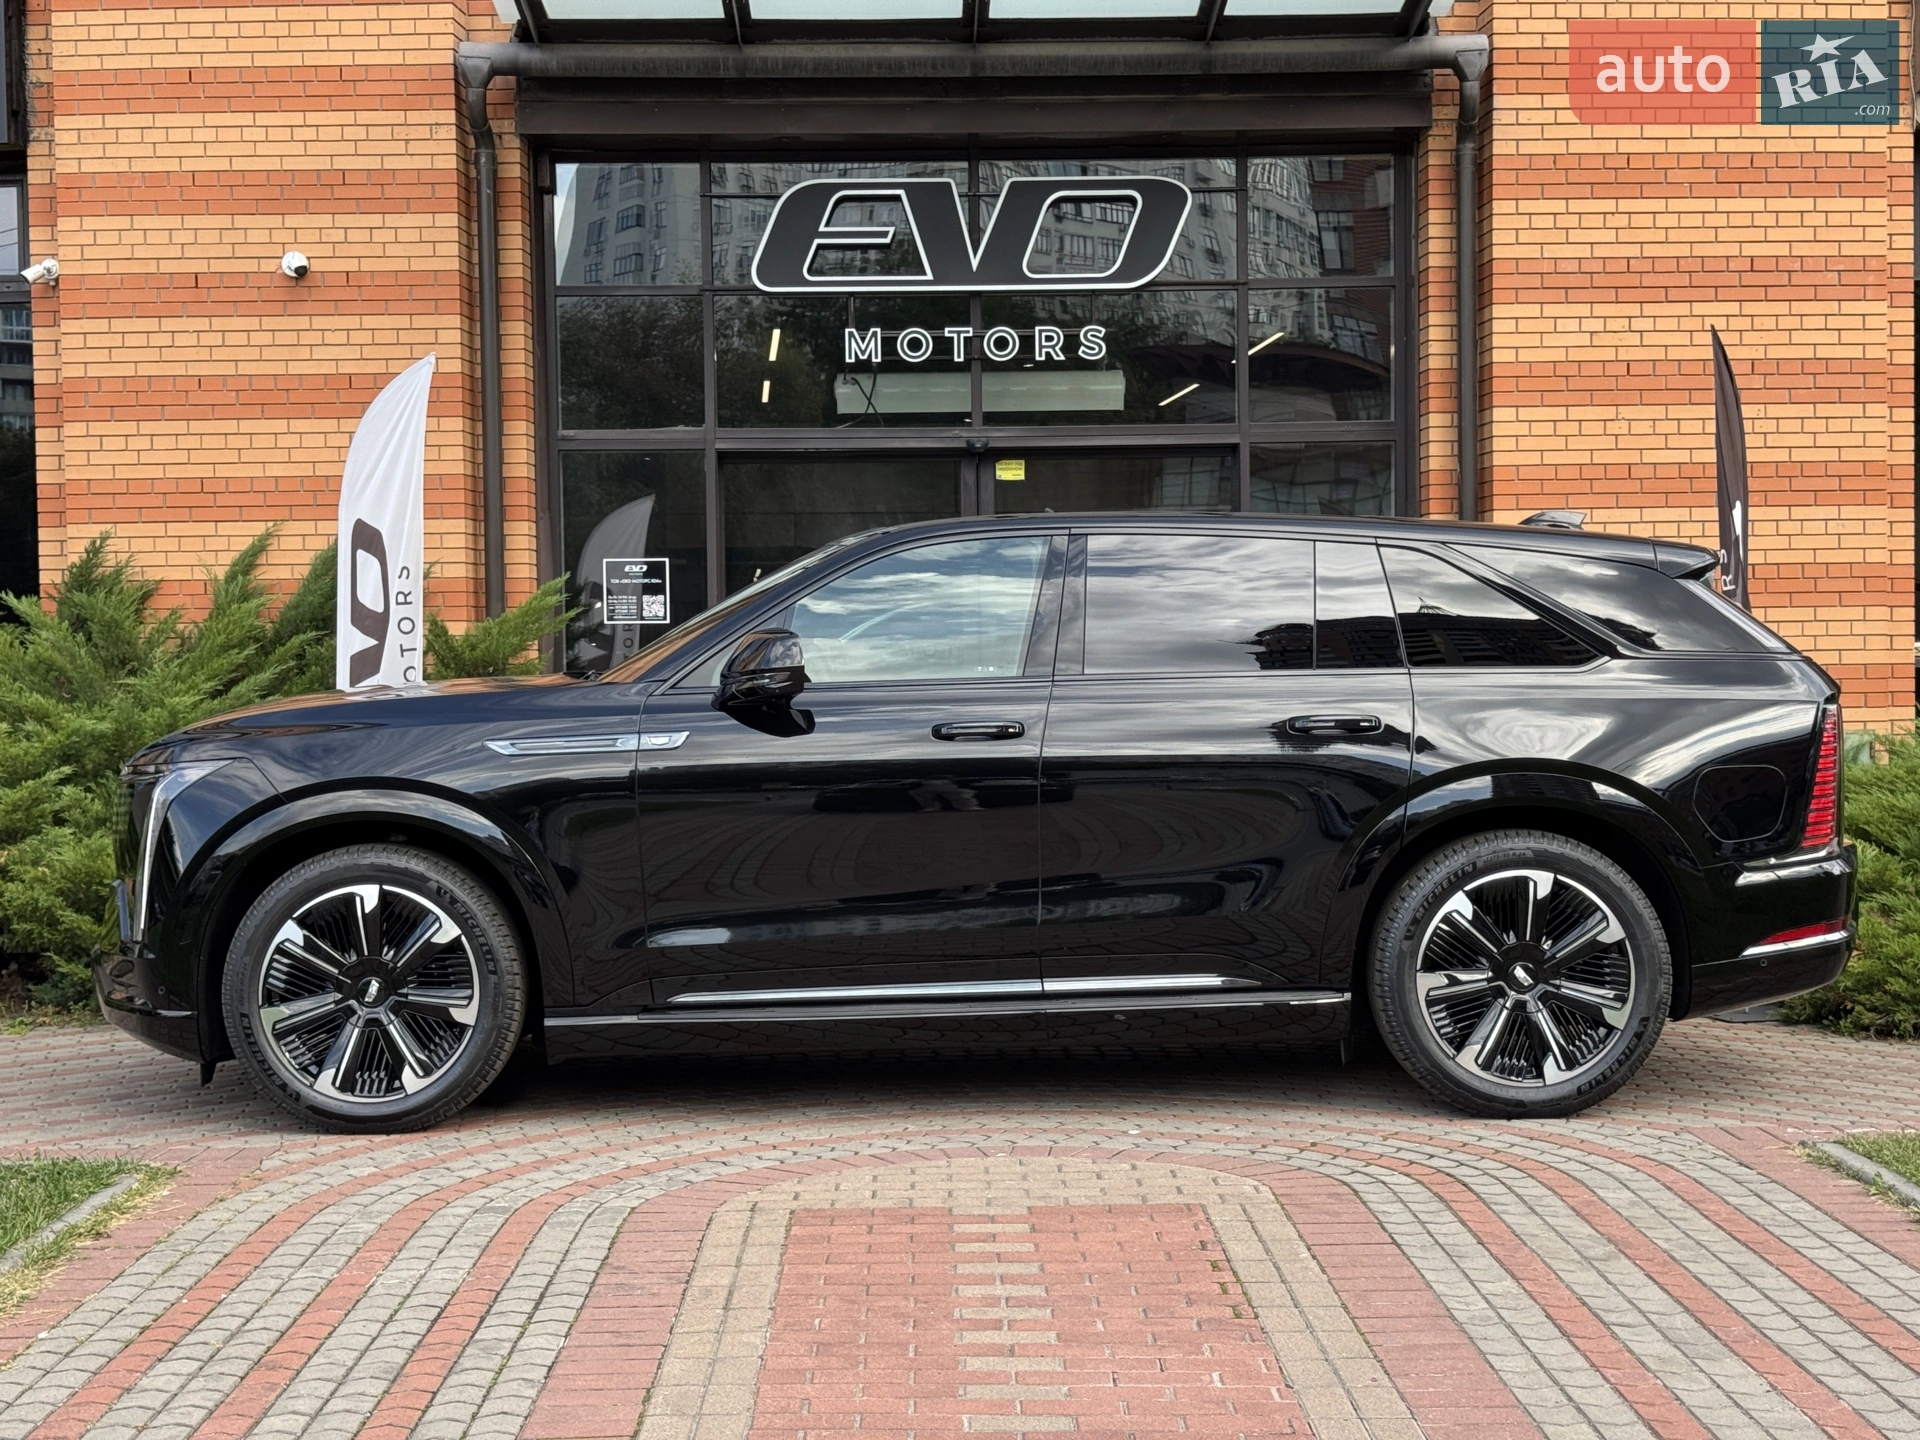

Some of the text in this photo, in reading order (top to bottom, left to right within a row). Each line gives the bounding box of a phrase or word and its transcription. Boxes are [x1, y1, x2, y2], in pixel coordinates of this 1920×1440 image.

[750, 175, 1193, 293] EVO
[844, 325, 1107, 362] MOTORS
[624, 564, 648, 572] EVO
[349, 517, 391, 688] VO
[1415, 862, 1474, 922] MICHELIN
[453, 902, 497, 971] MICHELIN
[241, 1016, 284, 1087] MICHELIN
[1580, 1035, 1639, 1093] MICHELIN
